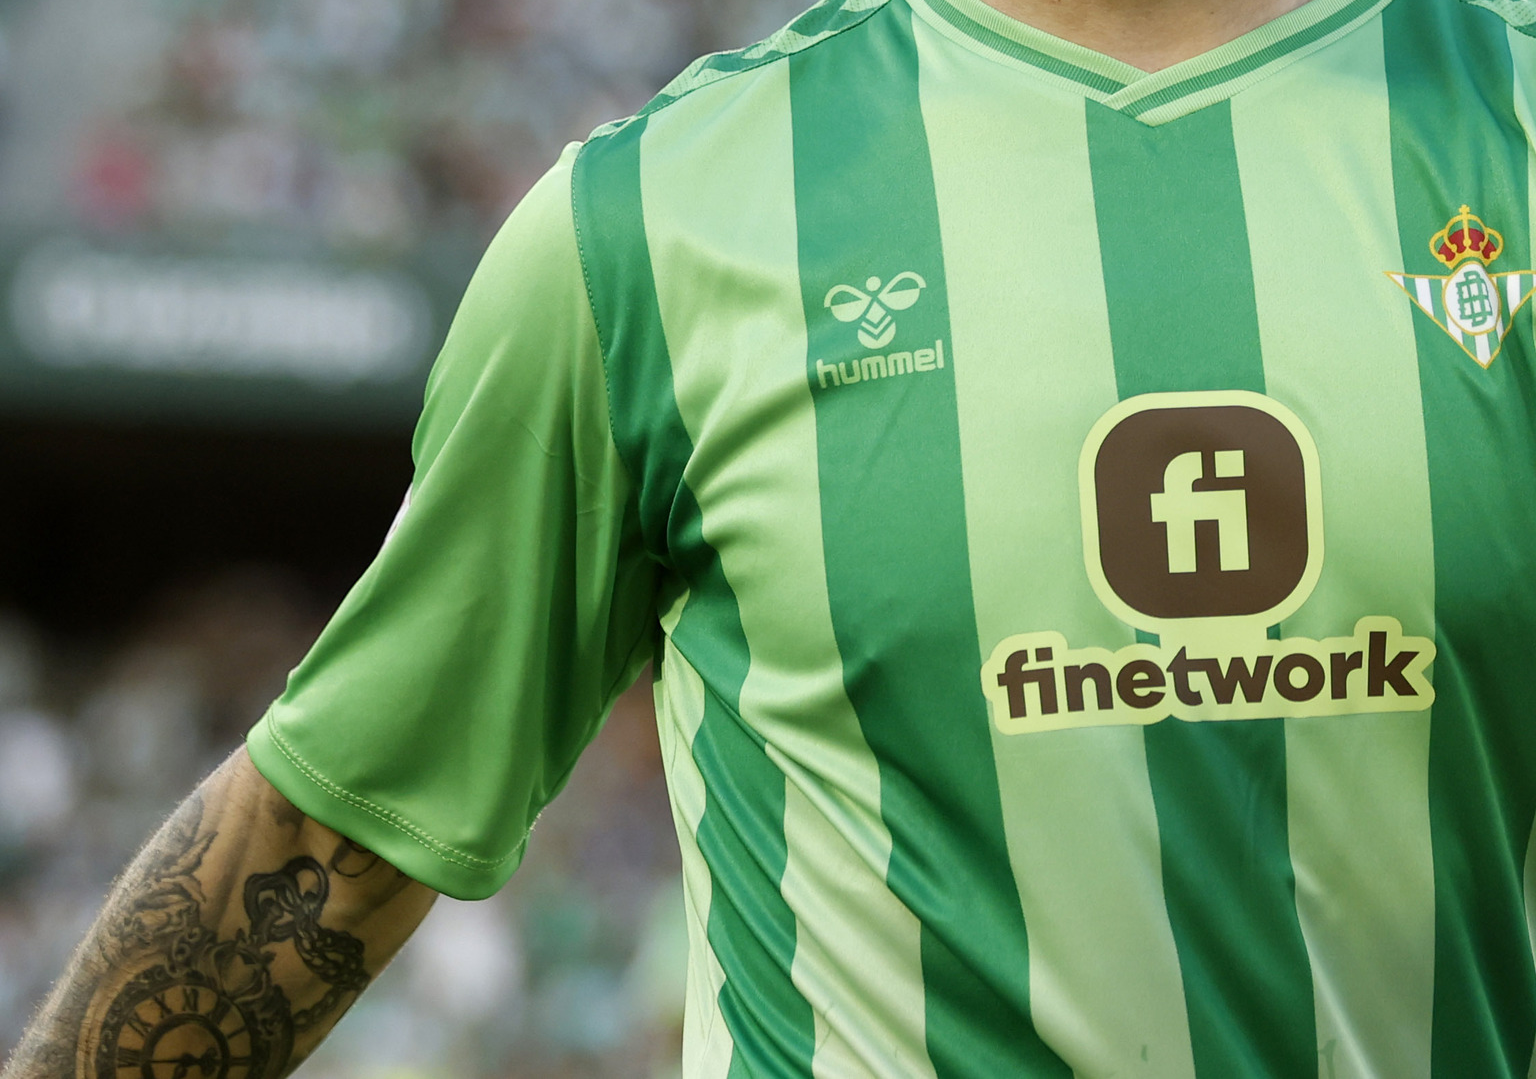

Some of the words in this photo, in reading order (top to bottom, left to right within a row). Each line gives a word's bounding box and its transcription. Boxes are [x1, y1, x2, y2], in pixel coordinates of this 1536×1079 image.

[816, 339, 944, 389] hummel
[1150, 450, 1250, 574] fi
[997, 631, 1420, 719] finetwork
